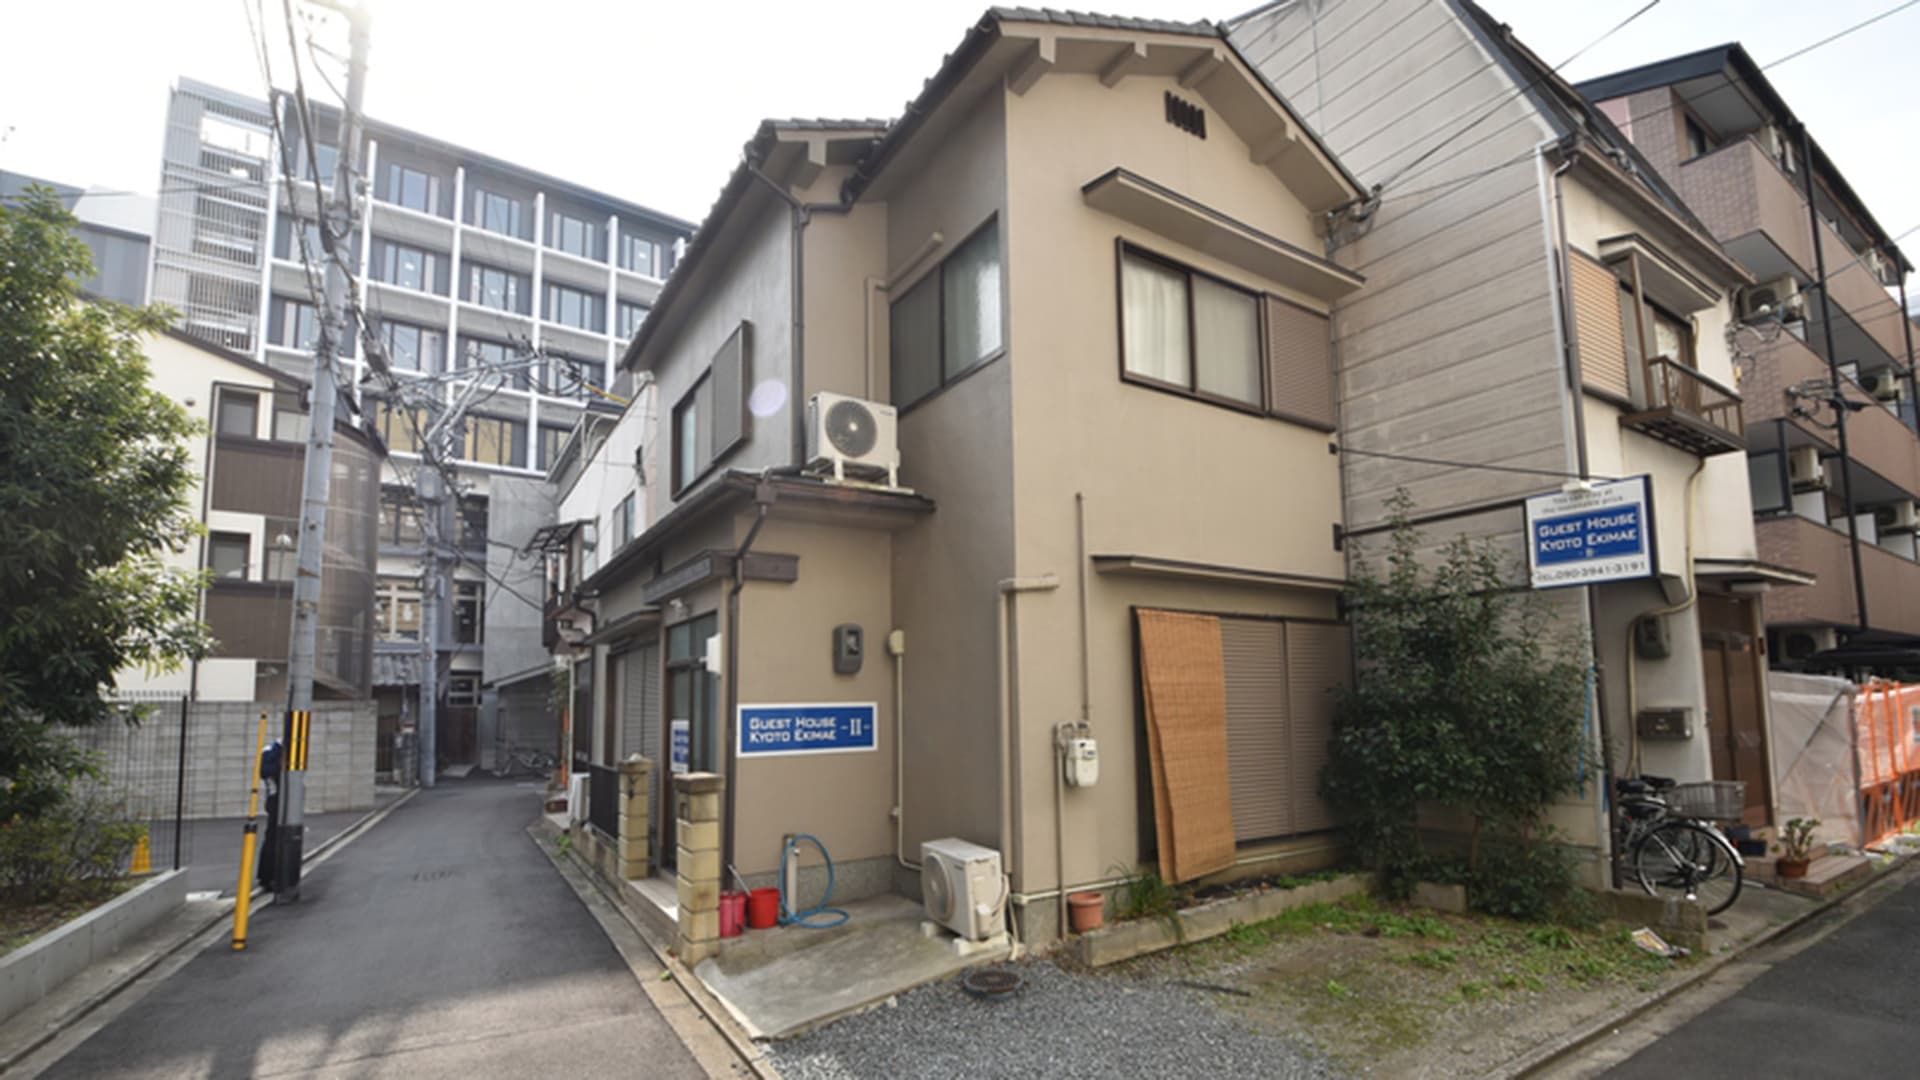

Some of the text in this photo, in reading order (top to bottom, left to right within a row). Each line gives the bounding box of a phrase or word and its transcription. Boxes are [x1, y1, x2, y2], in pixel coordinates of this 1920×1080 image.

[1539, 513, 1636, 537] GUEST HOUSE
[1540, 529, 1637, 552] KYOTO EKIMAE
[749, 716, 836, 730] GUEST HOUSE
[749, 729, 836, 743] KYOTO EKIMAE
